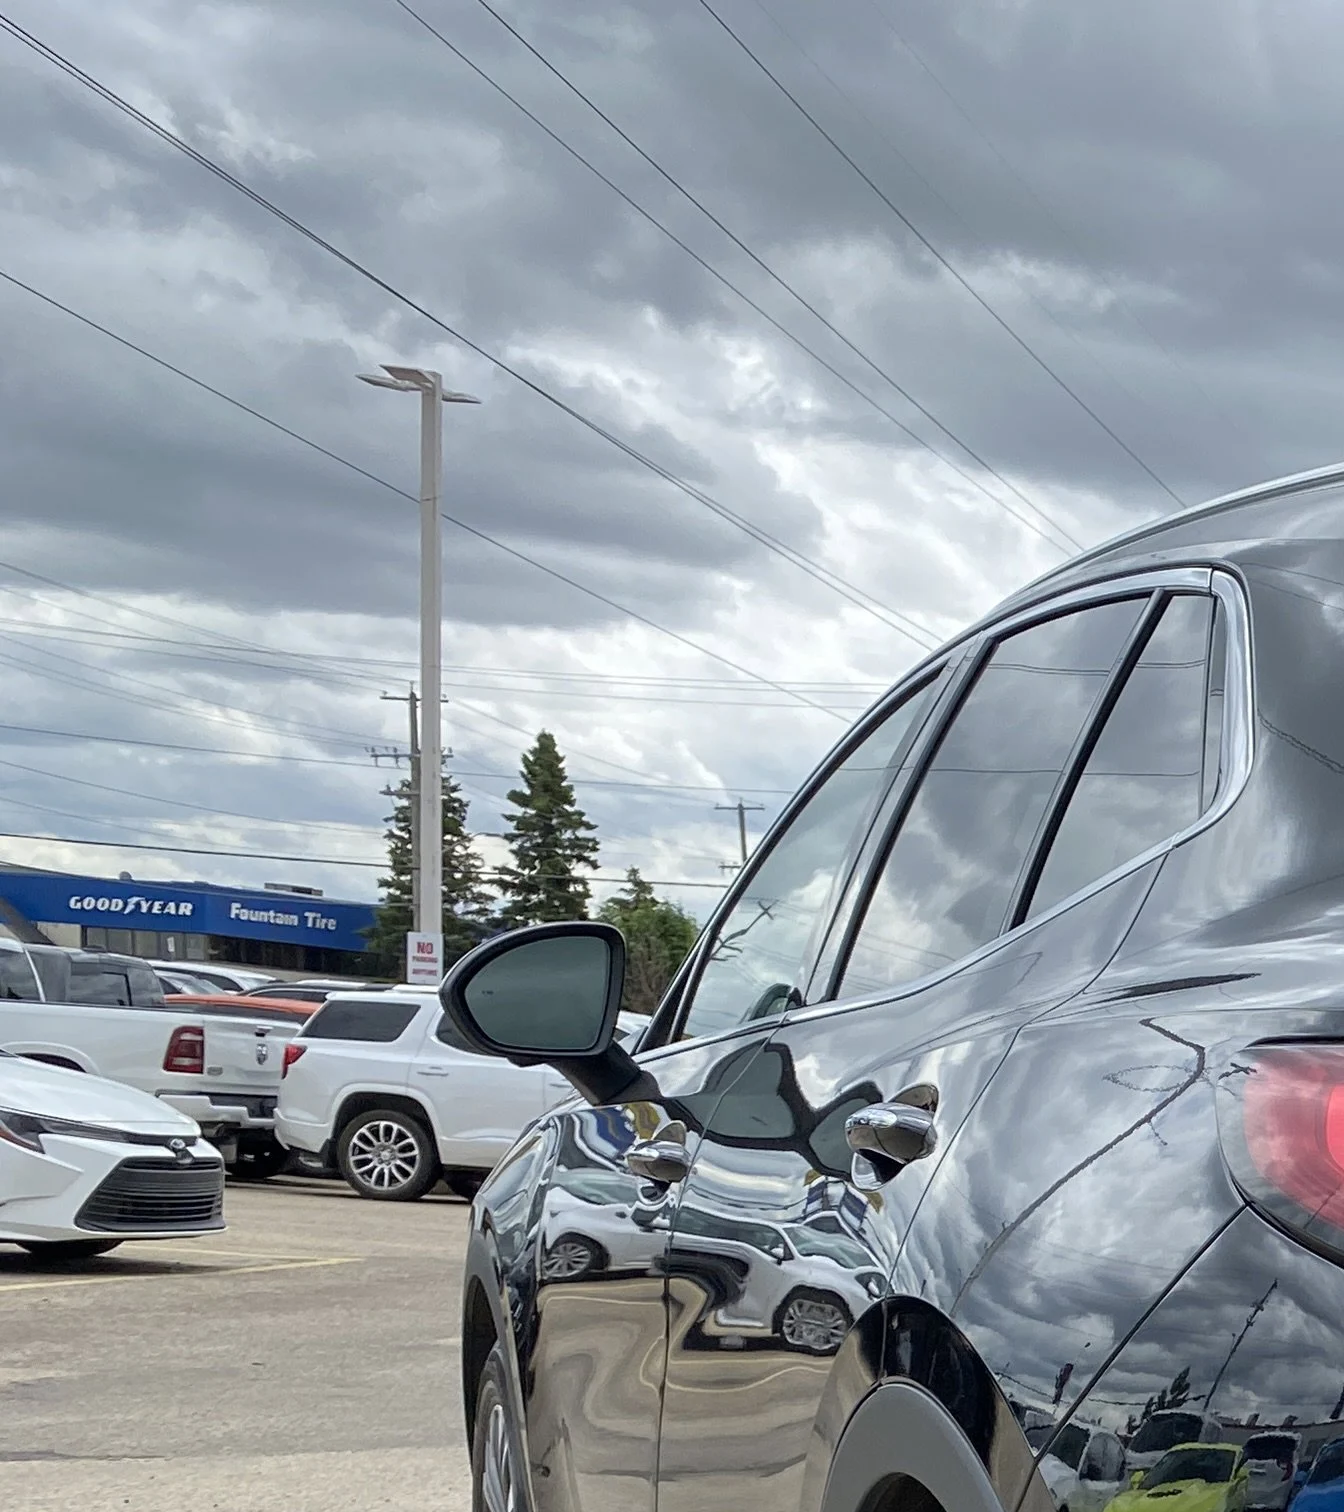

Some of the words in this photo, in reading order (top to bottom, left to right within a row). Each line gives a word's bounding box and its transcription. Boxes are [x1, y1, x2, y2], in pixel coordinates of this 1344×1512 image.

[69, 895, 193, 916] GOODYEAR
[230, 903, 298, 927] Fountain
[304, 911, 337, 930] Tire
[416, 941, 434, 955] NO
